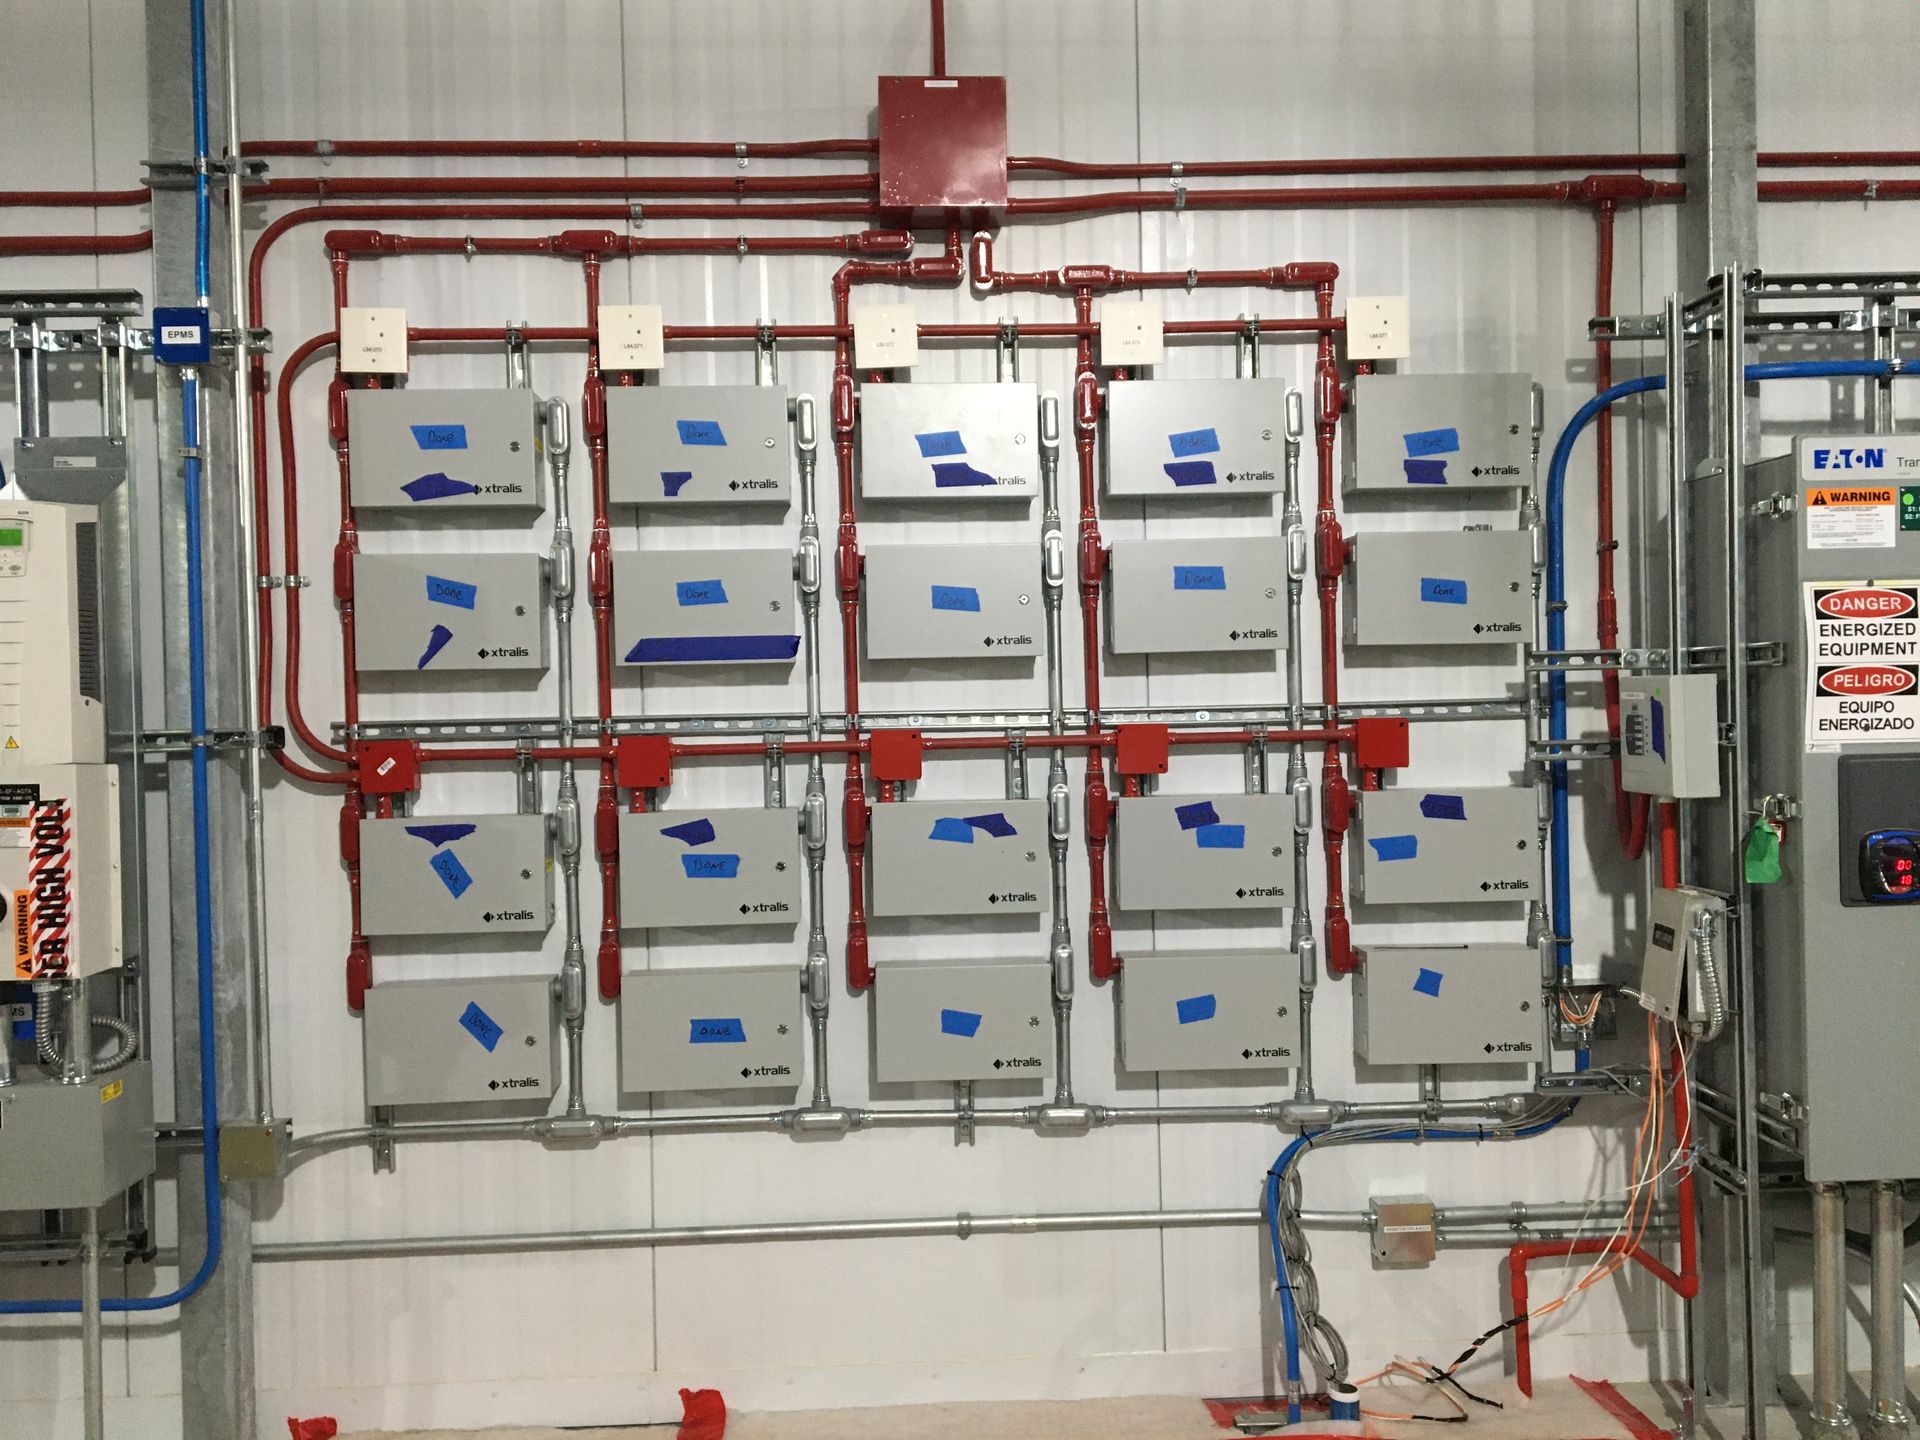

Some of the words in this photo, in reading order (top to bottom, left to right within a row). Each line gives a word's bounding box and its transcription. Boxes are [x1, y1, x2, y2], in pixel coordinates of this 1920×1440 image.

[167, 330, 194, 339] EPMS
[1813, 448, 1884, 470] EATON
[1239, 470, 1275, 481] xtralis
[1484, 465, 1520, 476] xtralis
[741, 479, 779, 489] xtralis
[994, 476, 1026, 486] tralis
[483, 482, 523, 494] xtralis
[1830, 491, 1891, 503] WARNING
[436, 583, 463, 600] Done
[1830, 597, 1902, 611] DANGER
[1486, 622, 1522, 632] xtralis
[1819, 622, 1916, 637] ENERGIZED
[1242, 628, 1278, 639] xtralis
[996, 635, 1032, 646] xtralis
[491, 646, 529, 657] xtralis
[1819, 641, 1917, 657] EQUIPMENT
[1833, 673, 1905, 687] PELIGRO
[1839, 700, 1895, 714] EQUIPO
[1818, 717, 1915, 731] ENERGIZADO
[1493, 879, 1529, 890] xtralis
[1001, 892, 1037, 902] xtralis
[1248, 886, 1284, 897] xtralis
[35, 866, 67, 929] HIGH
[752, 902, 789, 913] xtralis
[496, 910, 534, 921] xtralis
[17, 894, 29, 956] WARNING
[1496, 1041, 1533, 1052] xtralis
[1254, 1047, 1291, 1058] xtralis
[1005, 1057, 1042, 1068] xtralis
[753, 1065, 791, 1076] xtralis
[502, 1077, 539, 1089] xtralis
